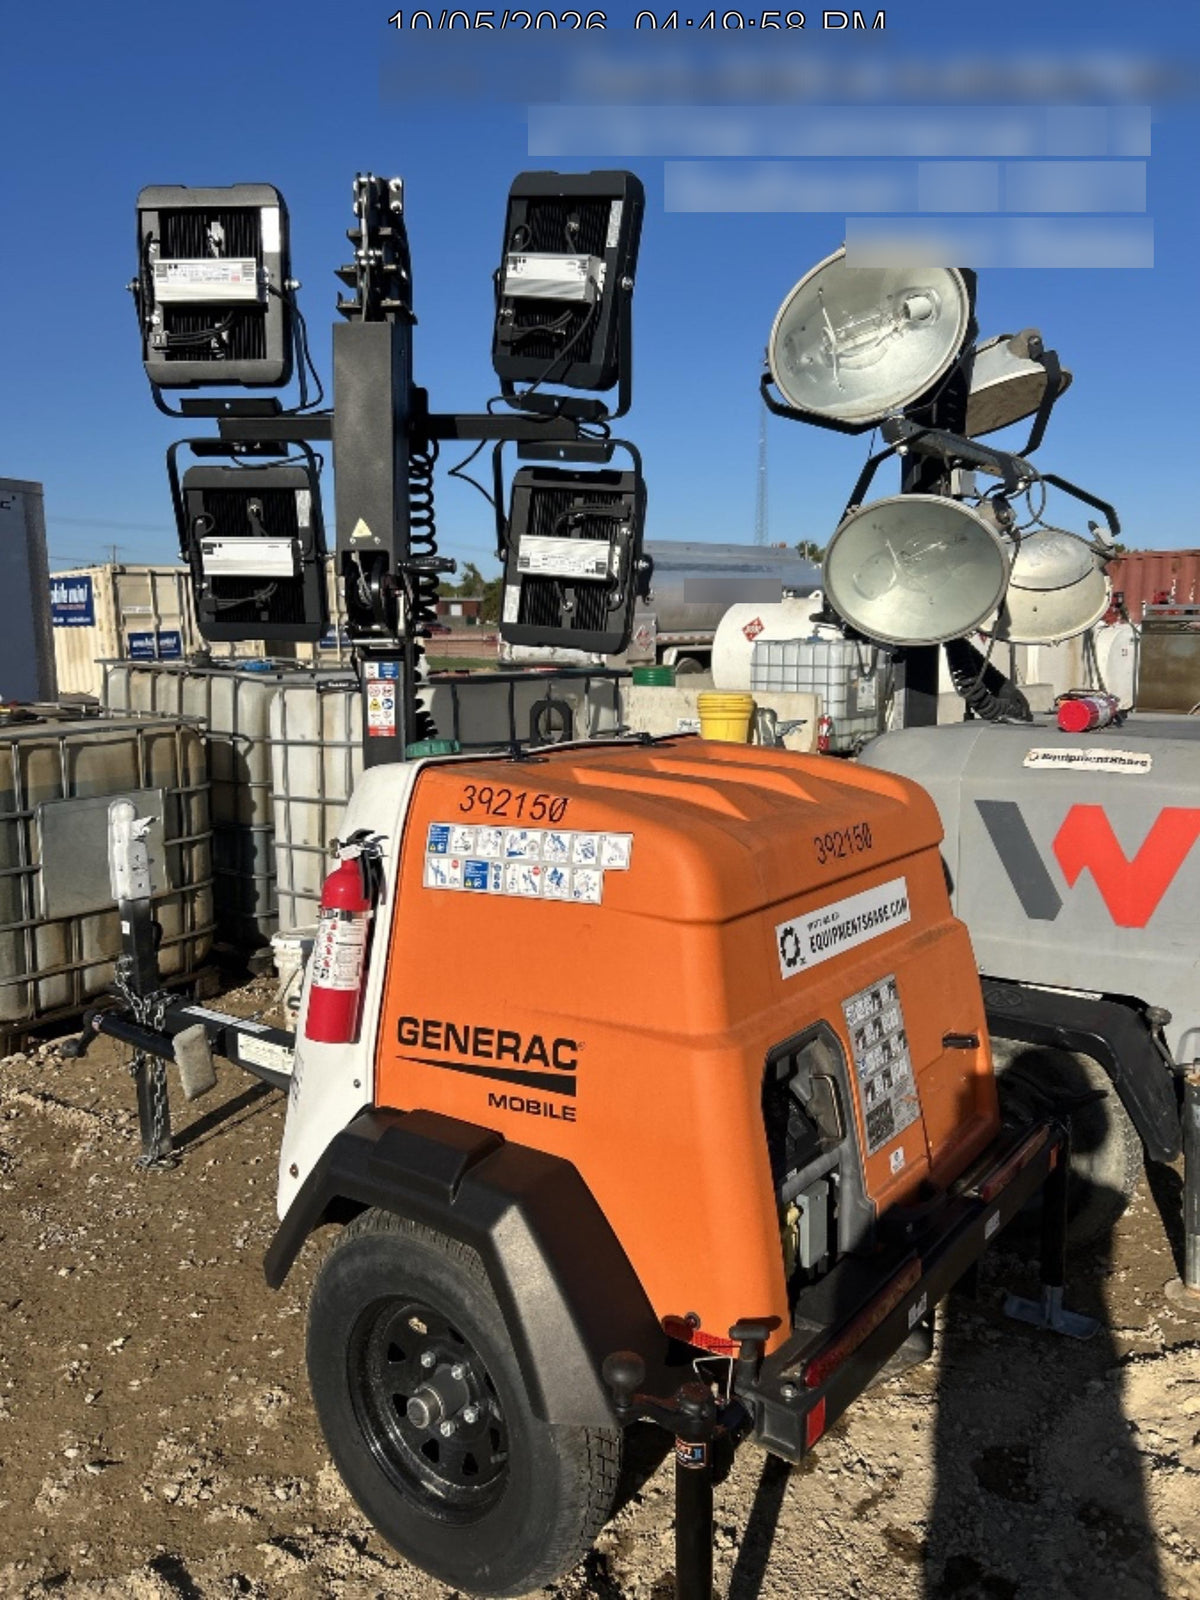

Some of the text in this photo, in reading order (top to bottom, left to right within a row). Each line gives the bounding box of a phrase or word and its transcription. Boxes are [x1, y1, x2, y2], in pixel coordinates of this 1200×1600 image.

[459, 784, 569, 823] 392150
[813, 822, 873, 865] 392150
[488, 1092, 577, 1123] MOBILE
